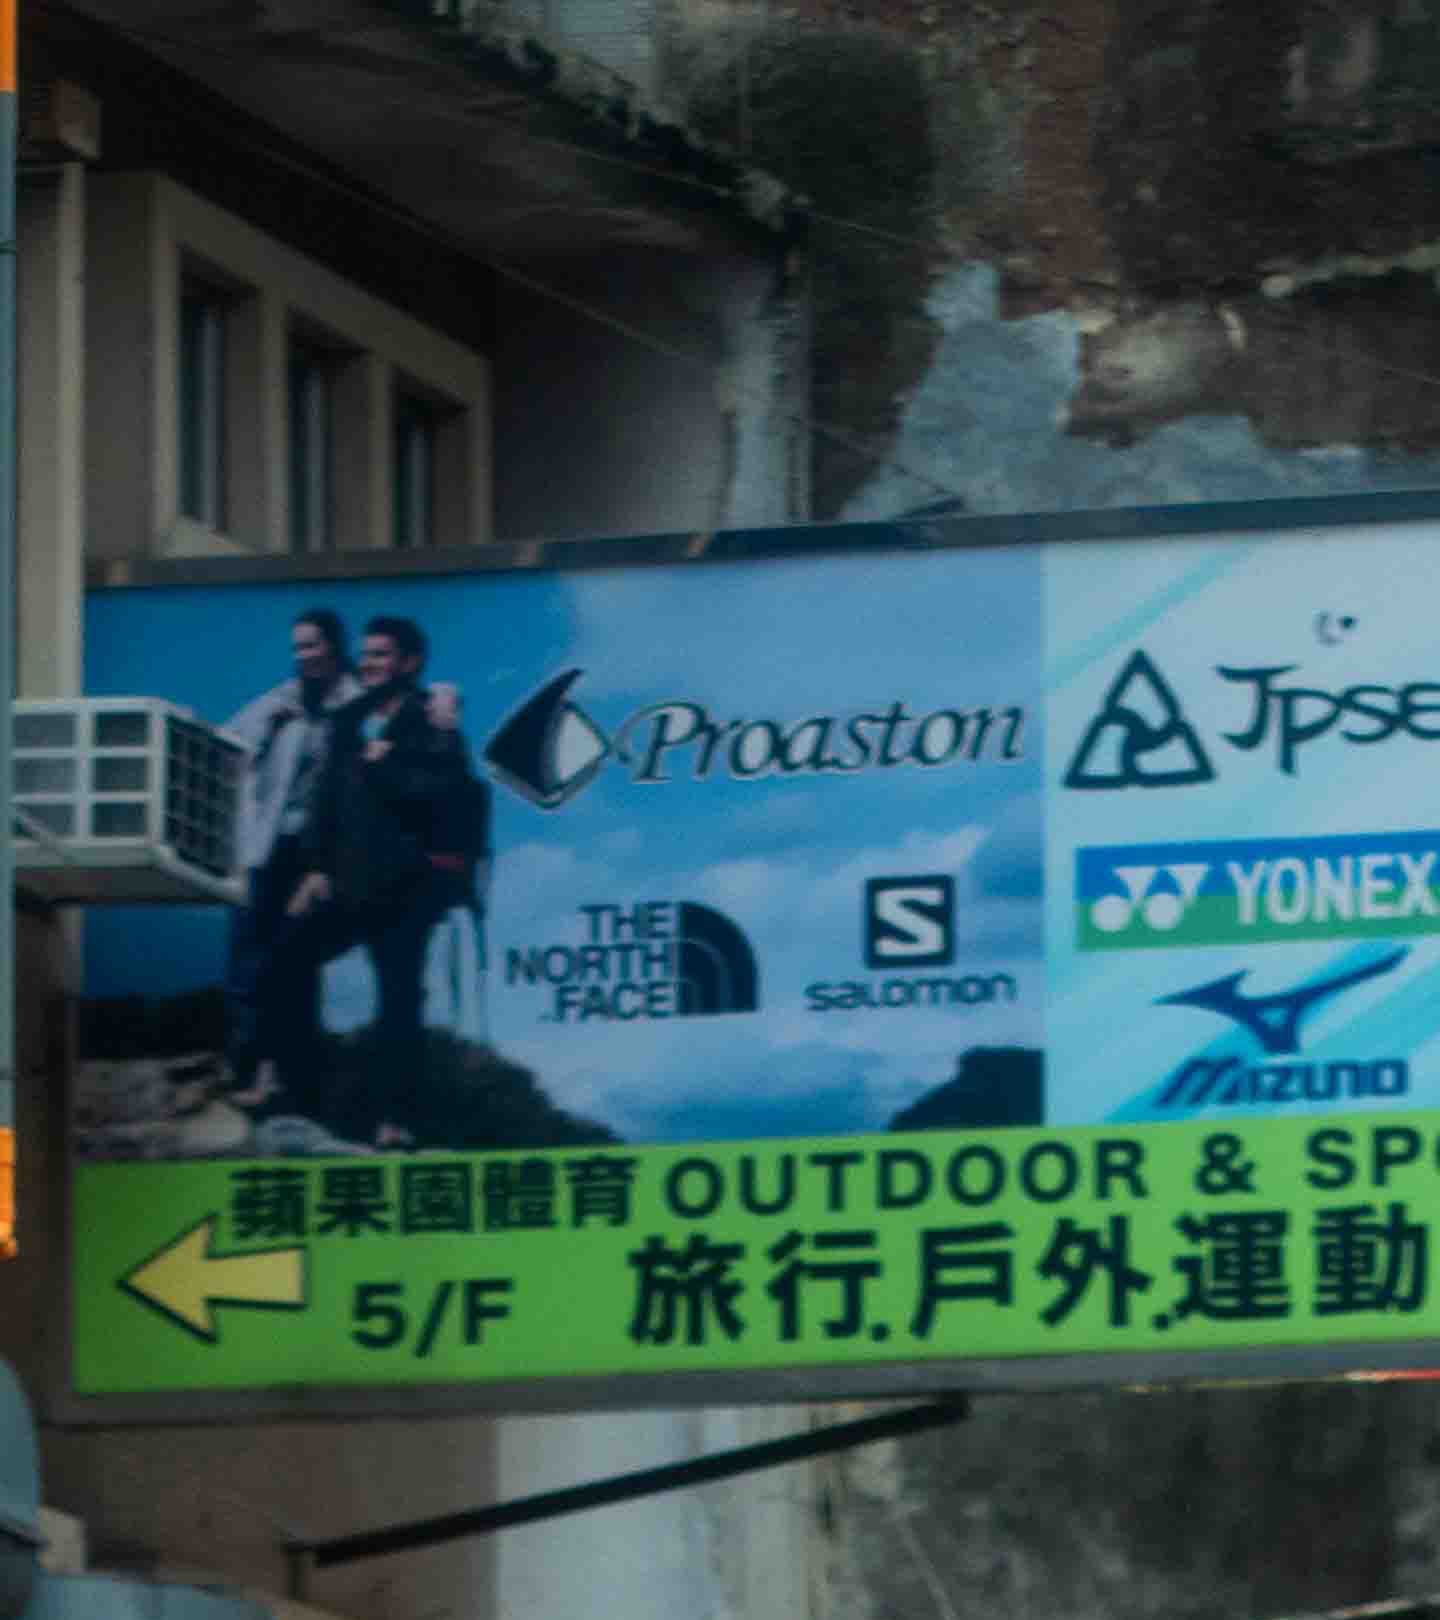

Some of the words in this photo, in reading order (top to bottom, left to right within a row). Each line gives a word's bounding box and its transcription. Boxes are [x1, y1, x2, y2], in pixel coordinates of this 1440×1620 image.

[612, 698, 1026, 785] Proaston
[576, 900, 672, 944] THE
[506, 941, 673, 984] NORTH
[557, 980, 673, 1020] FACE
[664, 1137, 1150, 1218] OUTDOOR
[1194, 1132, 1257, 1197] &
[350, 1277, 514, 1359] 5/F
